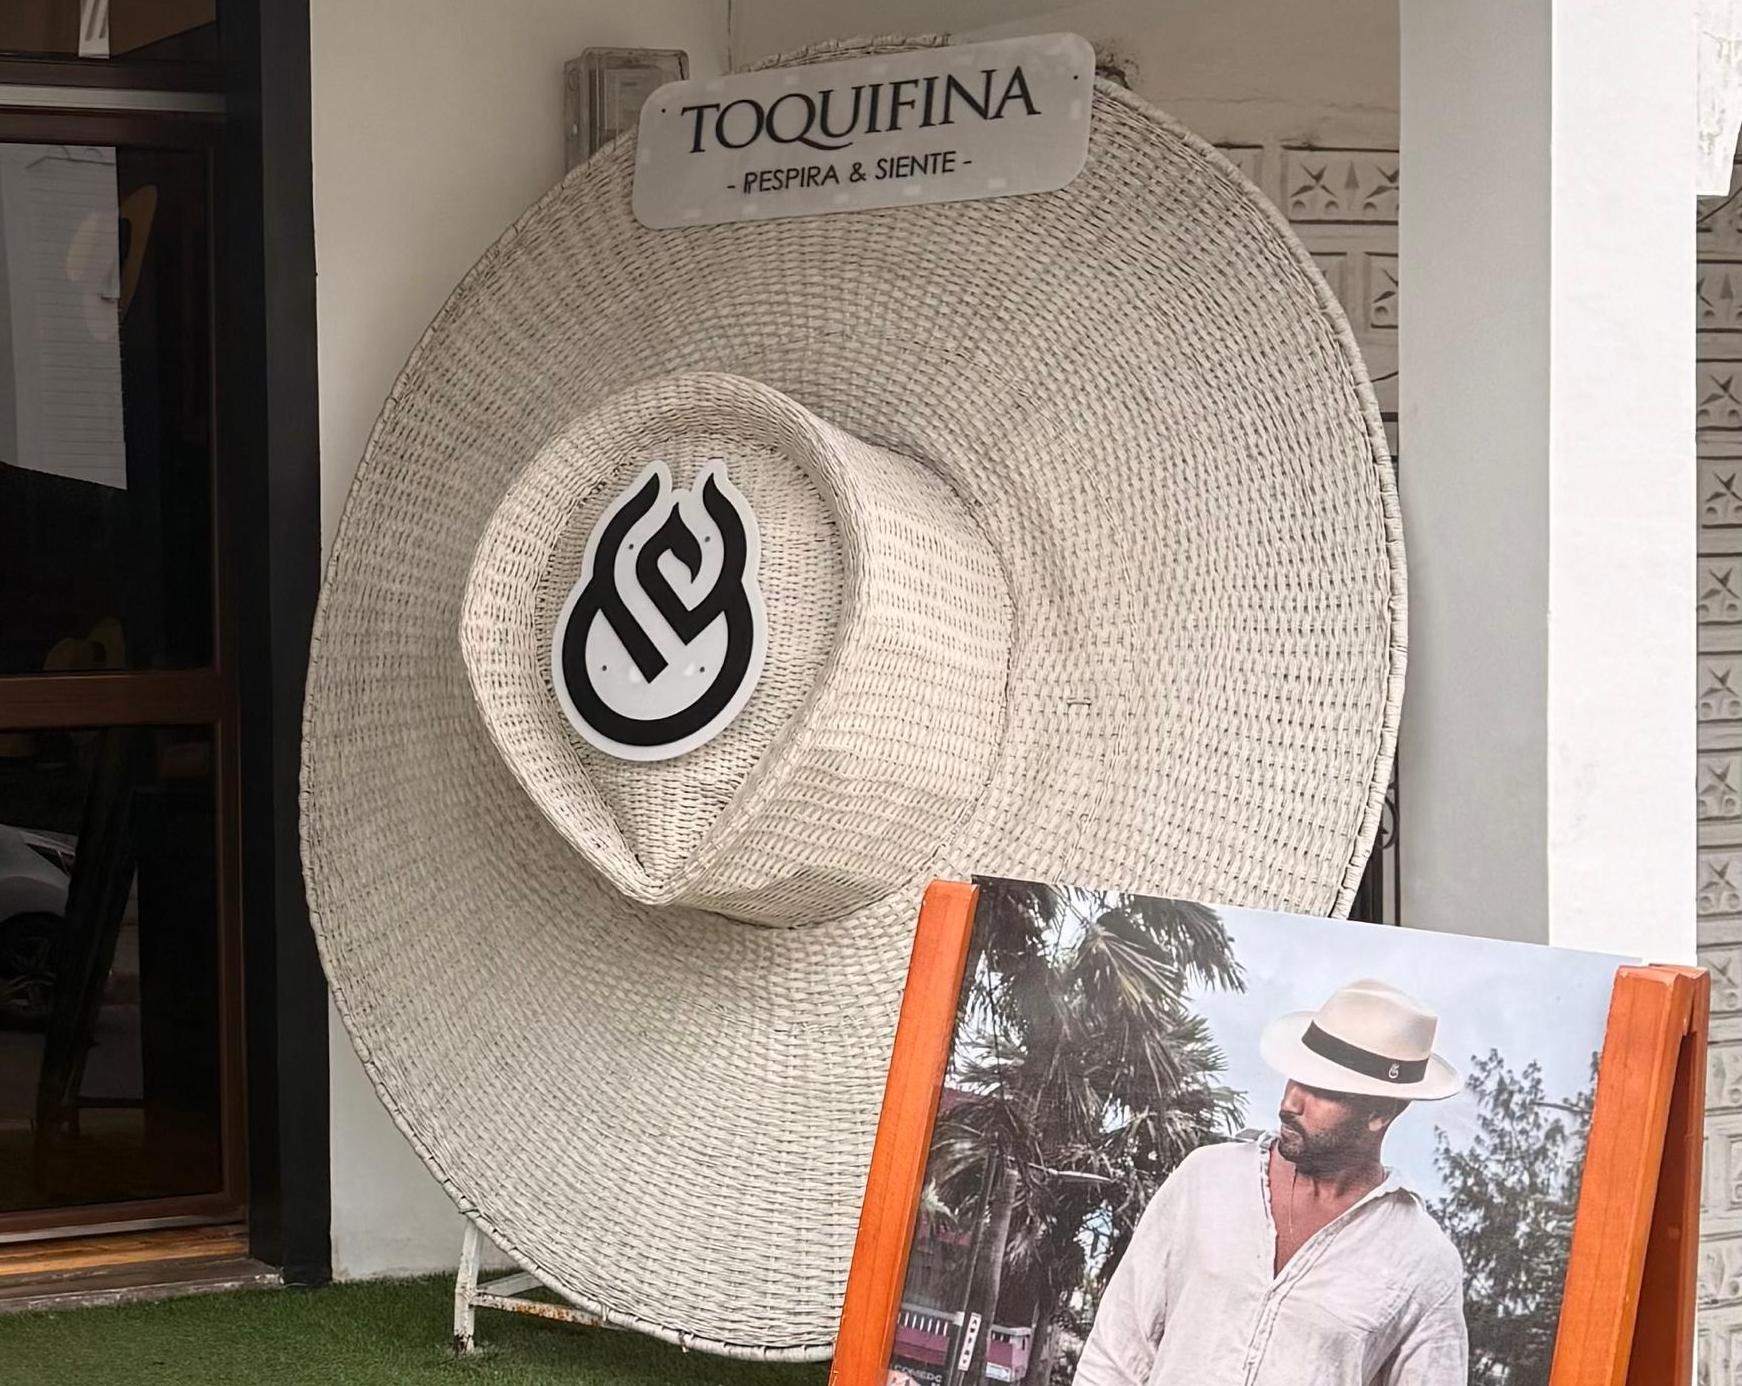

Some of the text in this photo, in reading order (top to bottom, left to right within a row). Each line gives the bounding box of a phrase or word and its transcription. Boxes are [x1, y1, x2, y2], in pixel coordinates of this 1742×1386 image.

[680, 65, 1042, 153] TOQUIFINA
[849, 161, 867, 183] &
[875, 150, 957, 181] SIENTE
